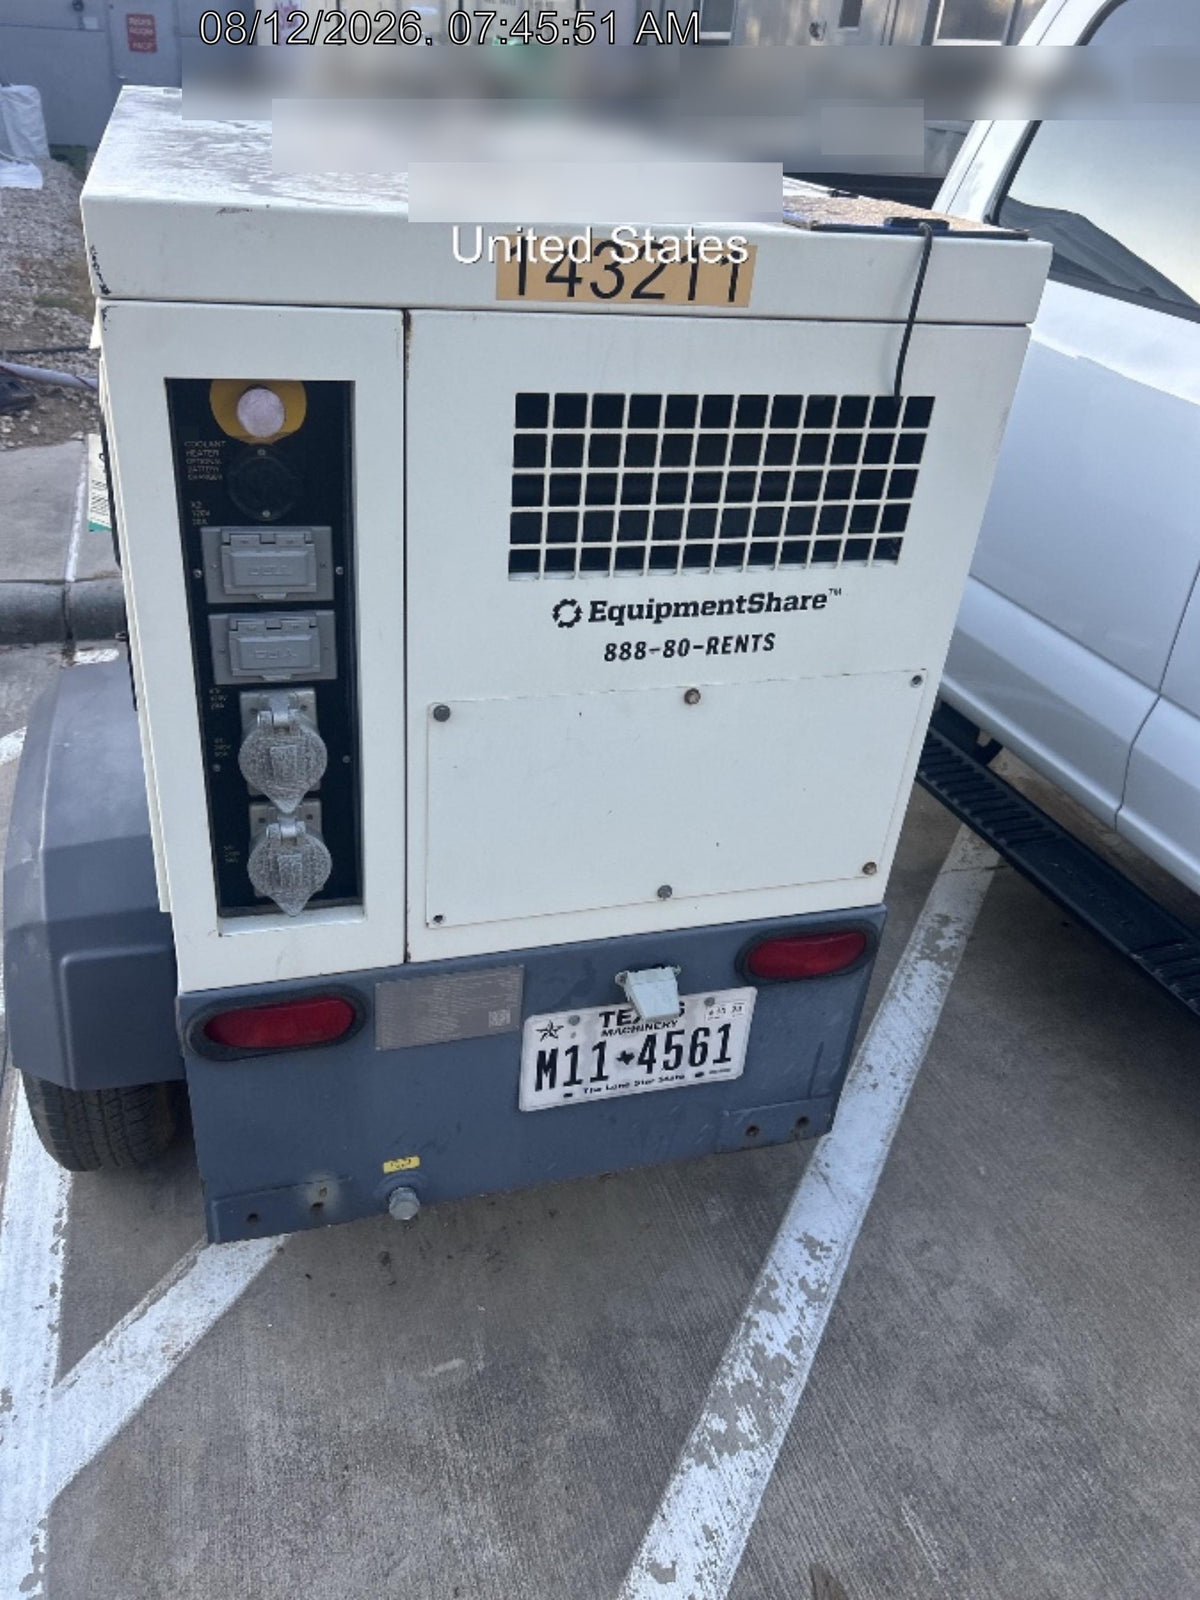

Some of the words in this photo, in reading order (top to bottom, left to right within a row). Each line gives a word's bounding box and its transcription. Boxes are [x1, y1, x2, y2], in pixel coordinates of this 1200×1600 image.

[510, 236, 740, 302] 143211
[604, 633, 776, 661] 888-80-RENTS
[534, 1040, 609, 1092] M11
[637, 1023, 731, 1074] 4561
